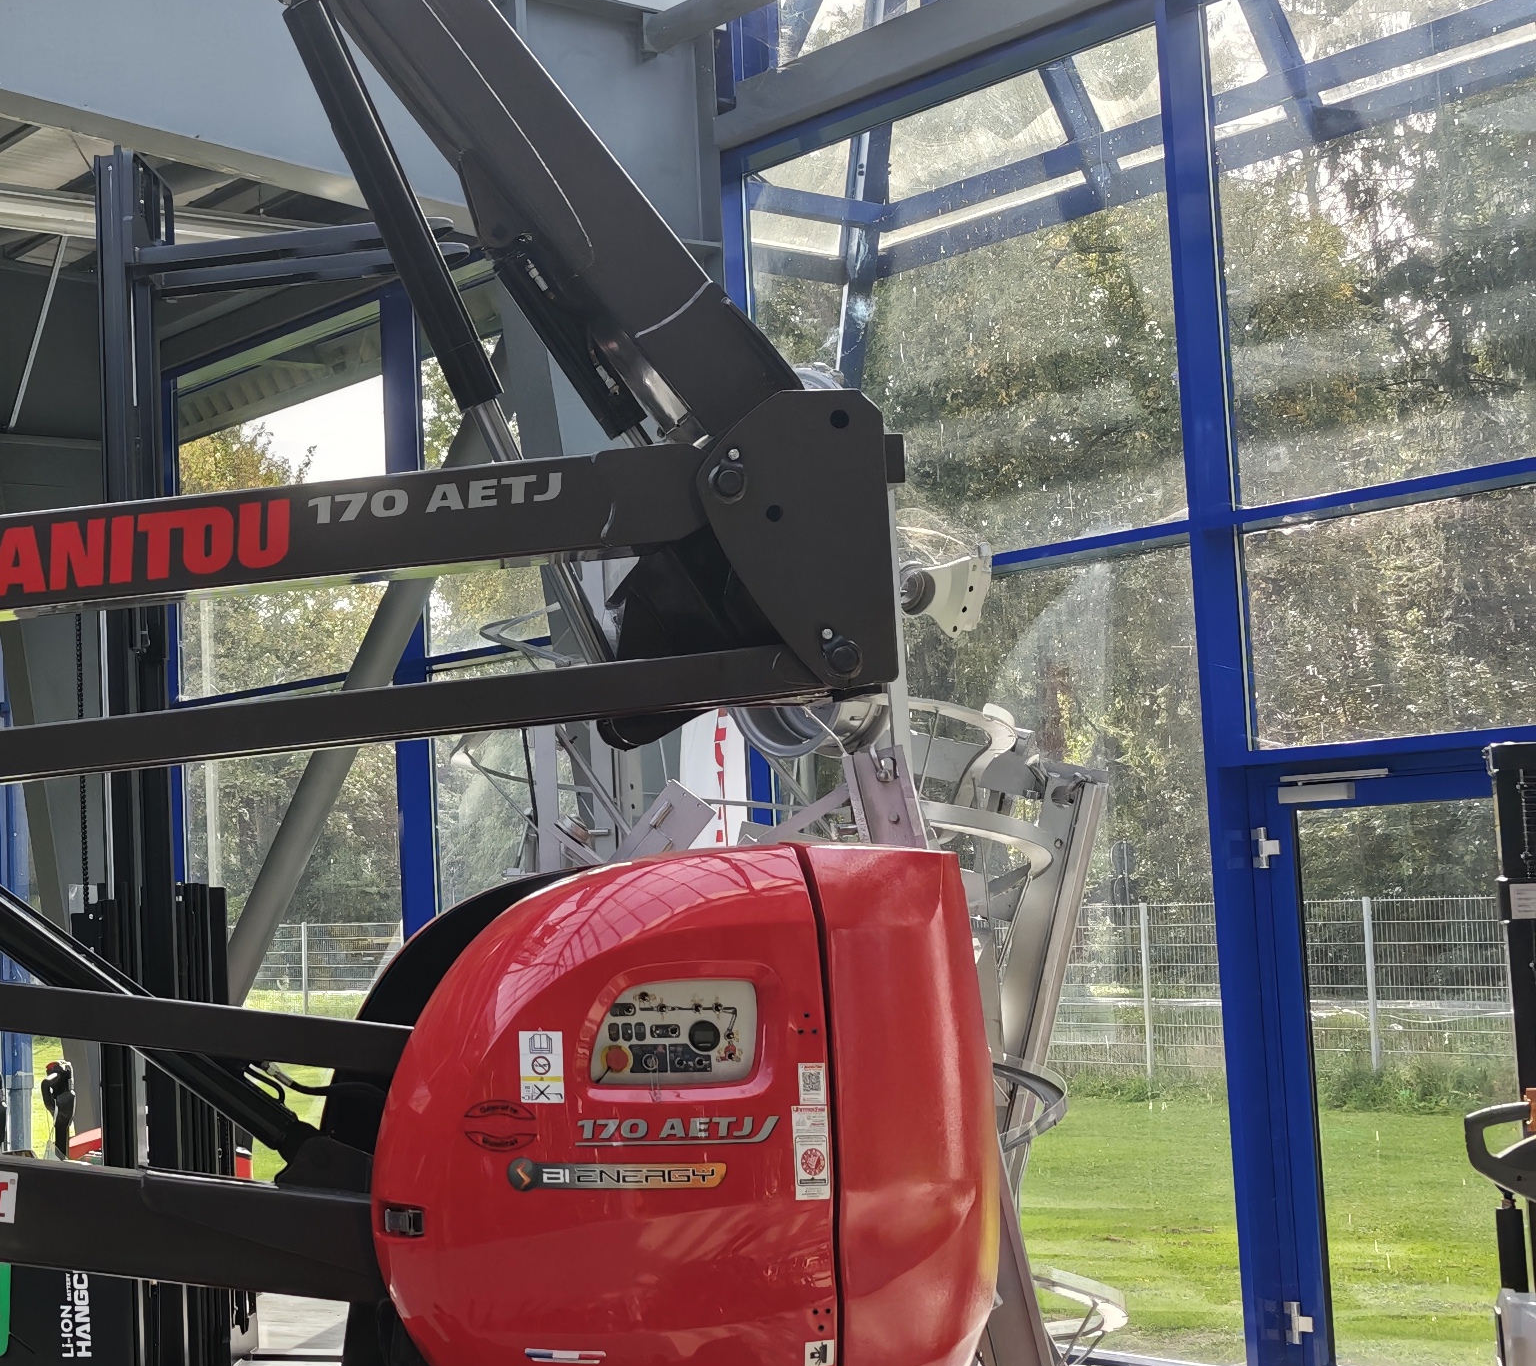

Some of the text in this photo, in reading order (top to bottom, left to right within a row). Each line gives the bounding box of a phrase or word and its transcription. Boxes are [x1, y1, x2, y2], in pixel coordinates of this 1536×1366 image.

[308, 487, 407, 525] 170
[425, 472, 563, 513] AETJ
[577, 1115, 756, 1140] 170 AETJ
[542, 1167, 715, 1184] BI ENERGY
[72, 1270, 92, 1358] HANGC
